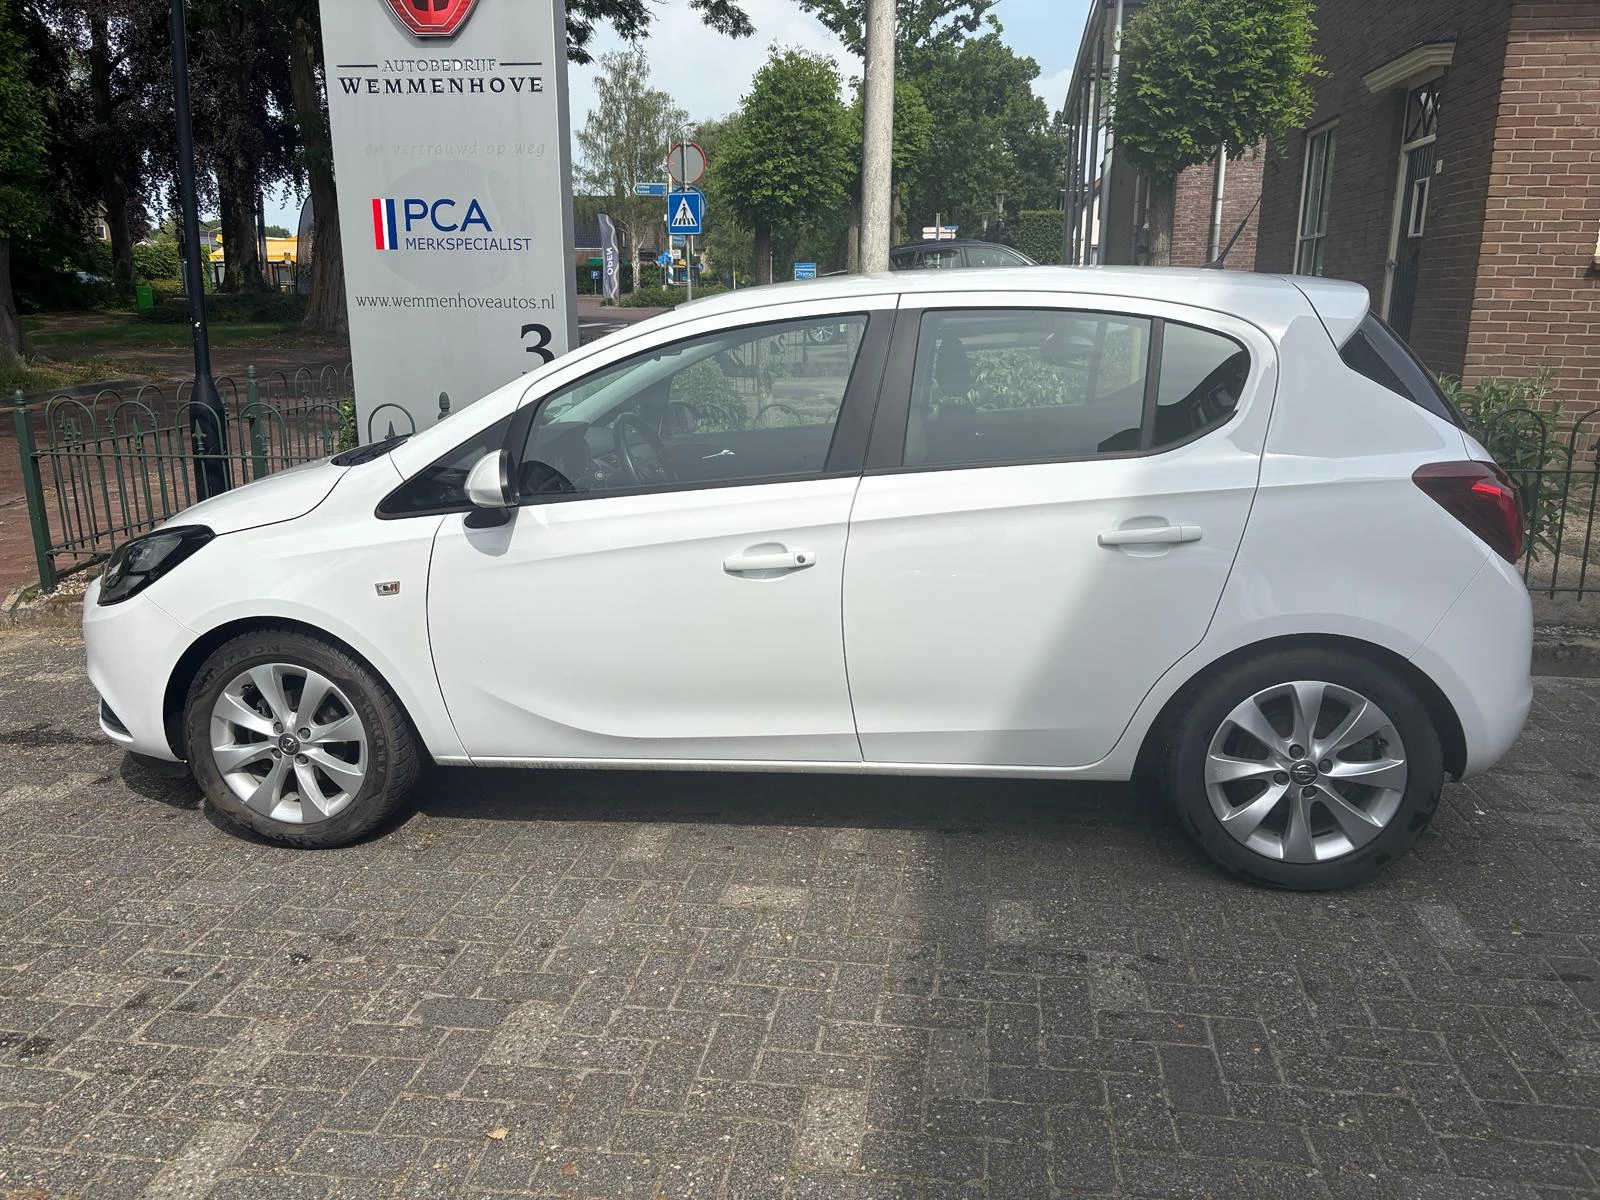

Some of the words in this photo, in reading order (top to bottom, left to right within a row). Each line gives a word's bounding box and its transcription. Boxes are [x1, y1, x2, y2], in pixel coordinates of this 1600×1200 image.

[382, 59, 497, 73] AUTOBEDRIJF
[337, 77, 544, 95] WEMMENHOVE
[486, 143, 506, 158] op
[515, 143, 546, 159] weg
[404, 199, 493, 232] PCA
[406, 238, 532, 251] MERKSPECIALIST
[355, 294, 555, 310] www.wemmenhoveautos.nl
[520, 323, 555, 374] 3
